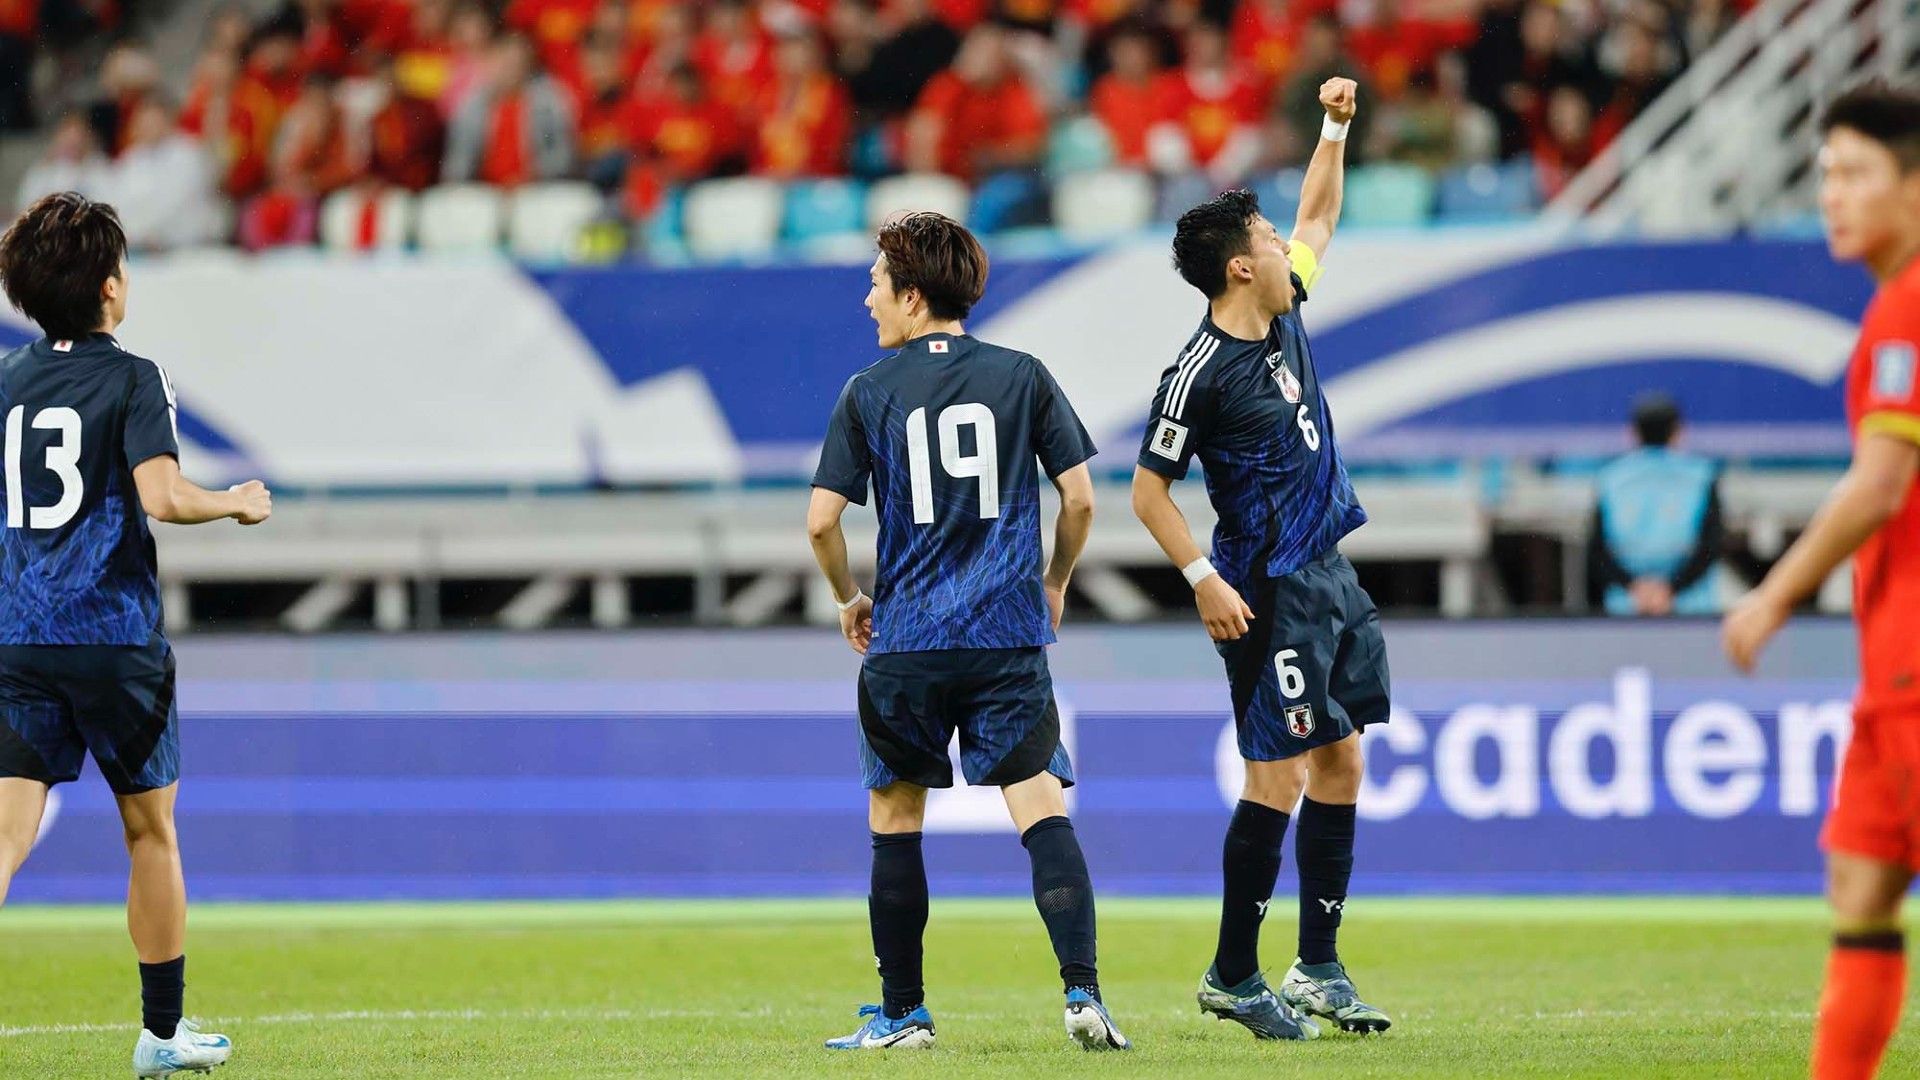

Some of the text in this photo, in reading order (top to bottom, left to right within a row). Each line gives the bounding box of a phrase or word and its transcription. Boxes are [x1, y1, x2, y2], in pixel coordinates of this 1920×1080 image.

[5, 404, 84, 529] 13
[906, 403, 999, 524] 19
[1297, 404, 1320, 452] 6
[1274, 649, 1305, 699] 6
[1214, 666, 1853, 821] cade
